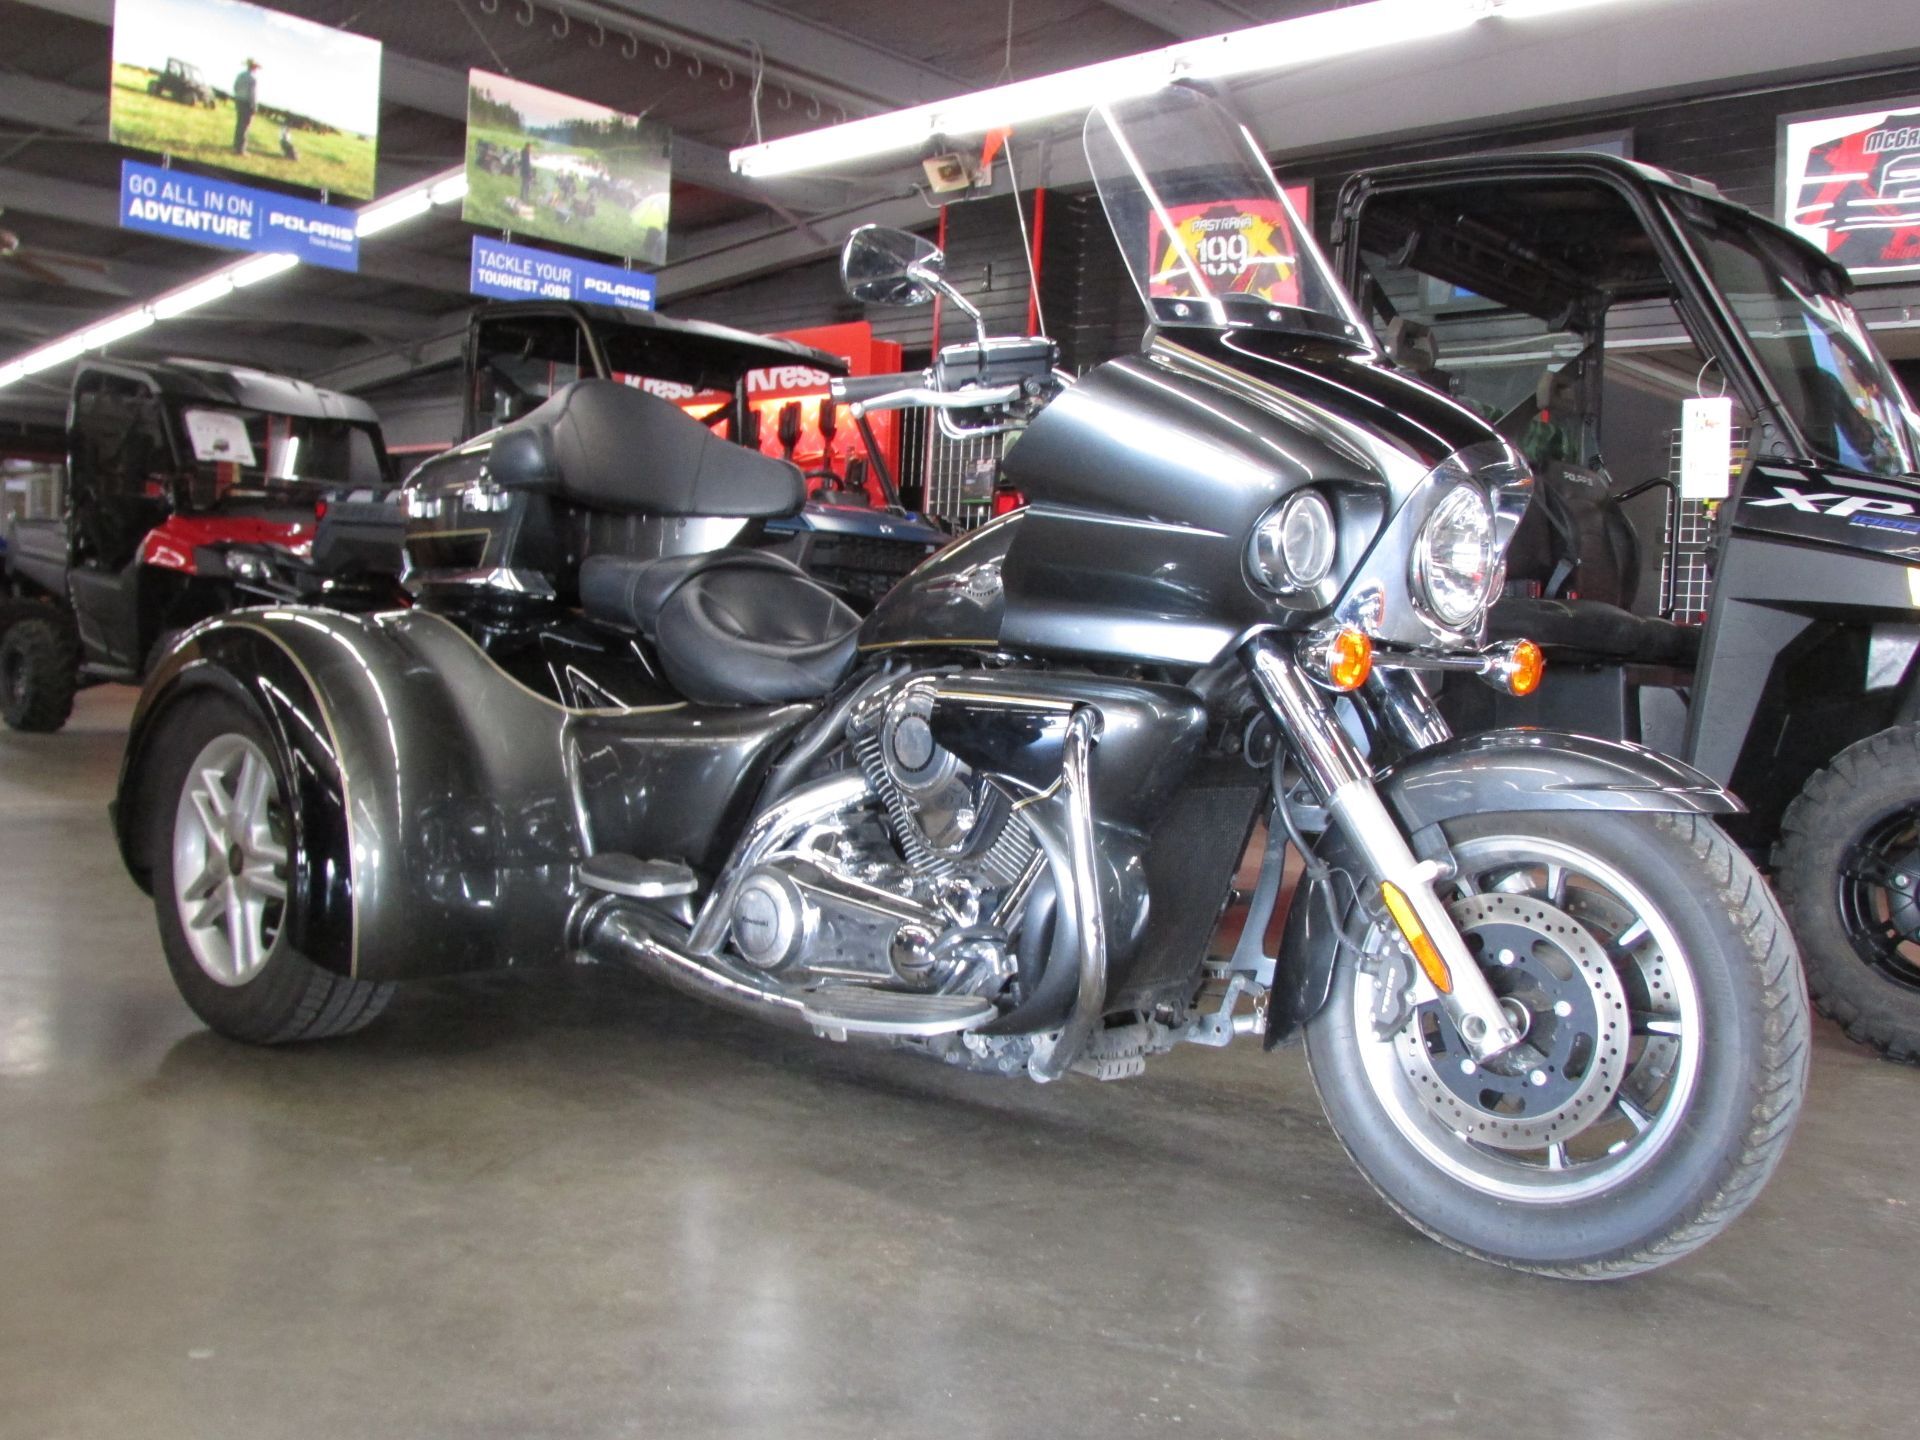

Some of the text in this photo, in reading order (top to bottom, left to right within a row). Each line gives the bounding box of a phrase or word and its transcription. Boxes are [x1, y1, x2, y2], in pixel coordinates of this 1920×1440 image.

[129, 174, 253, 218] GO ALL IN ON
[128, 198, 252, 240] ADVENTURE
[269, 212, 355, 242] POLARIS
[1192, 216, 1252, 232] PASTRANA
[479, 250, 572, 283] TACKLE YOUR
[1196, 235, 1249, 275] 199
[478, 269, 571, 299] TOUGHEST JOBS
[584, 278, 651, 301] POLARIS
[747, 365, 830, 393] Kress
[1745, 486, 1915, 517] XP
